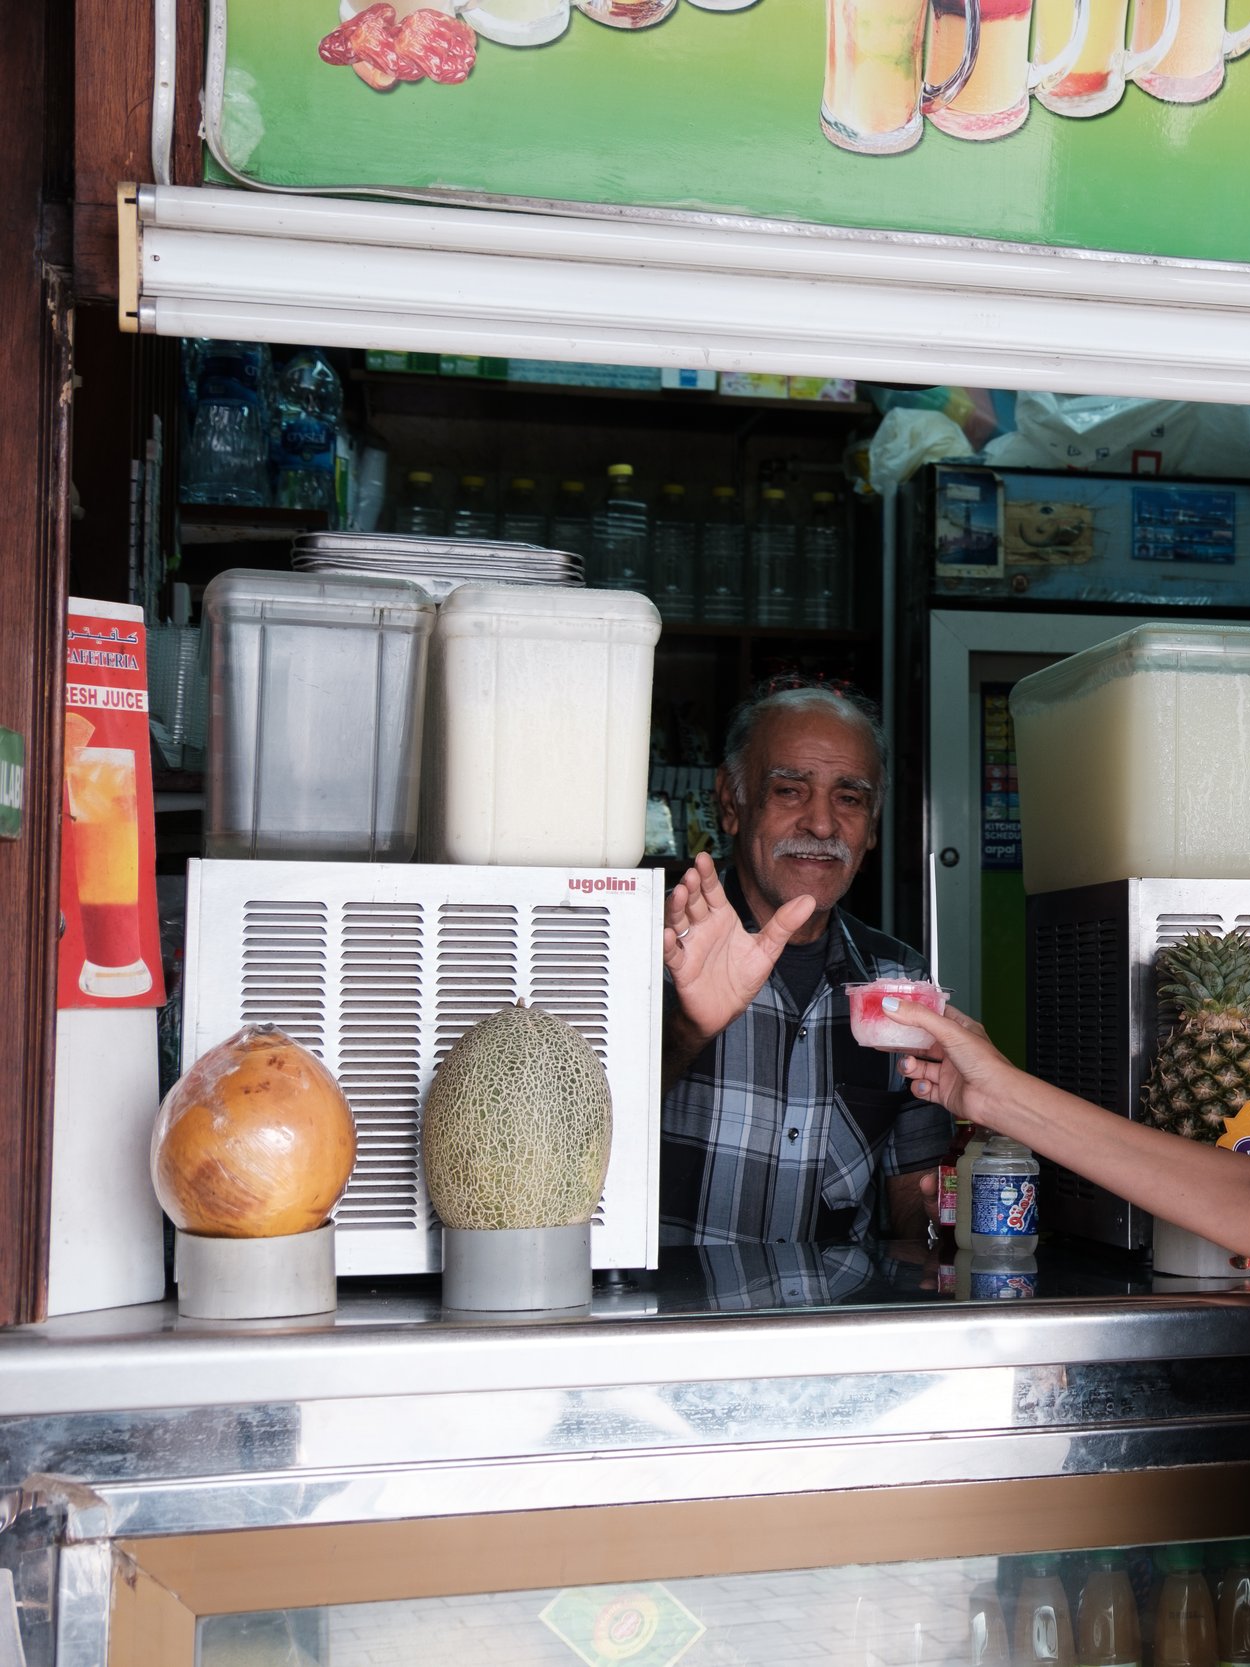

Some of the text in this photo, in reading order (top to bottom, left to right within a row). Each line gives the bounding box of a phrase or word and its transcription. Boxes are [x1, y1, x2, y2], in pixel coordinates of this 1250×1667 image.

[102, 690, 144, 709] JUICE
[984, 831, 1021, 840] SCHEDU
[568, 876, 637, 894] ugolini
